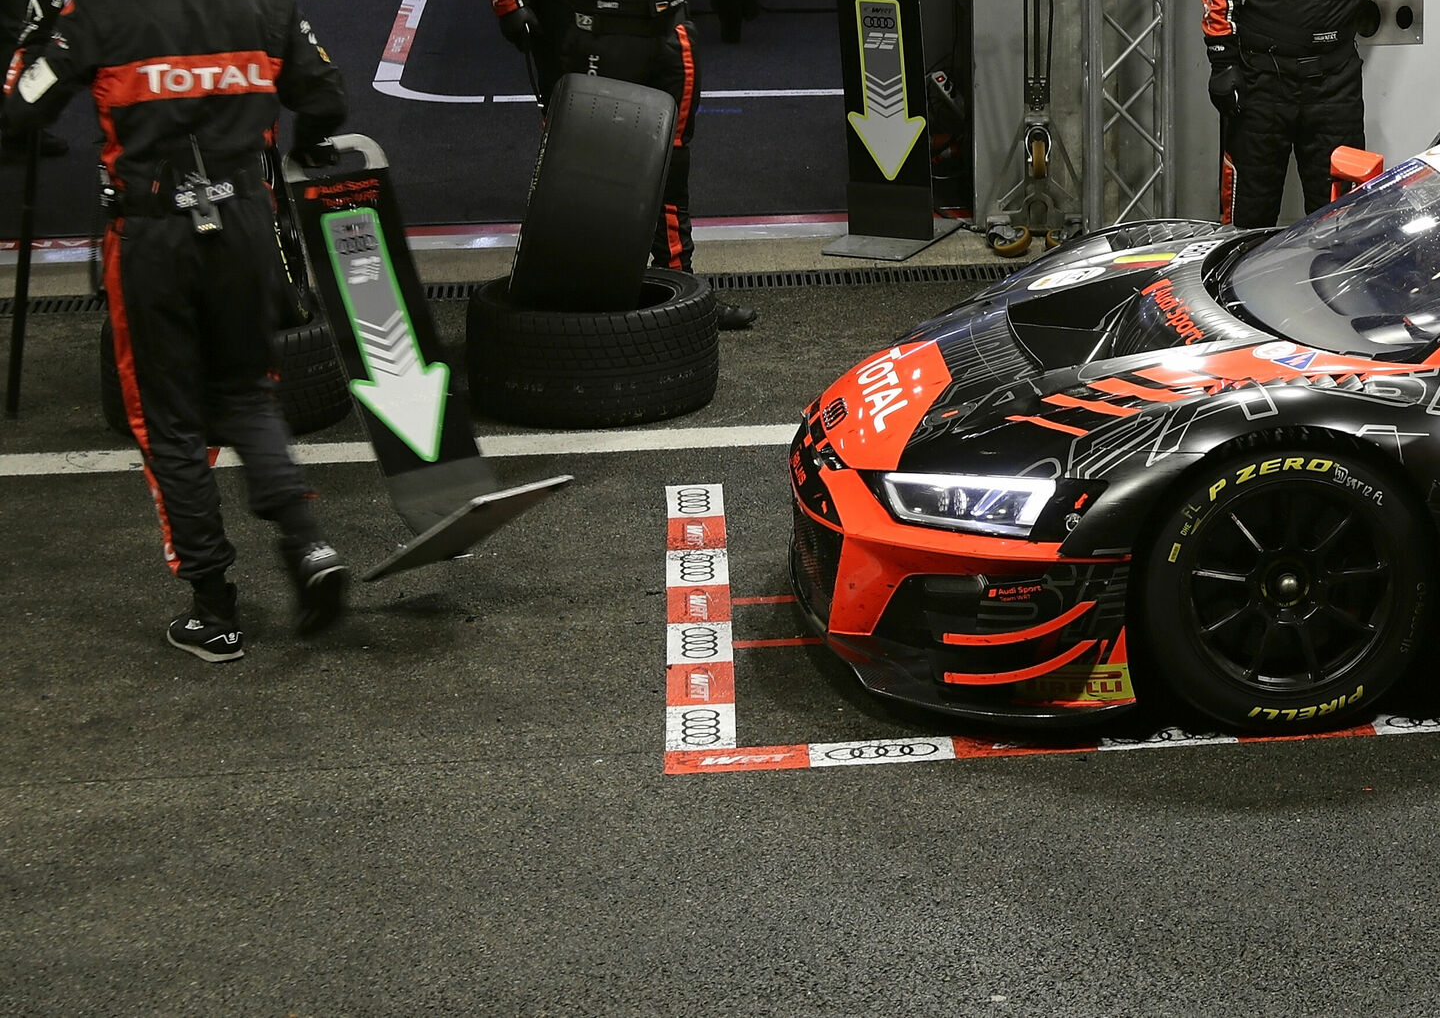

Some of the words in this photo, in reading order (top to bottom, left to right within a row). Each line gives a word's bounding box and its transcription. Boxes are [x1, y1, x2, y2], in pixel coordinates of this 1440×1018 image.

[137, 62, 273, 94] TOTAL
[1154, 286, 1185, 312] Audi
[1165, 305, 1206, 346] Sport
[856, 347, 909, 434] TOTAL
[1209, 478, 1227, 502] P
[1236, 457, 1335, 485] ZERO
[998, 587, 1017, 596] Audi
[1018, 585, 1042, 595] Sport
[690, 673, 710, 702] WRT
[1247, 684, 1365, 722] PIRELLI
